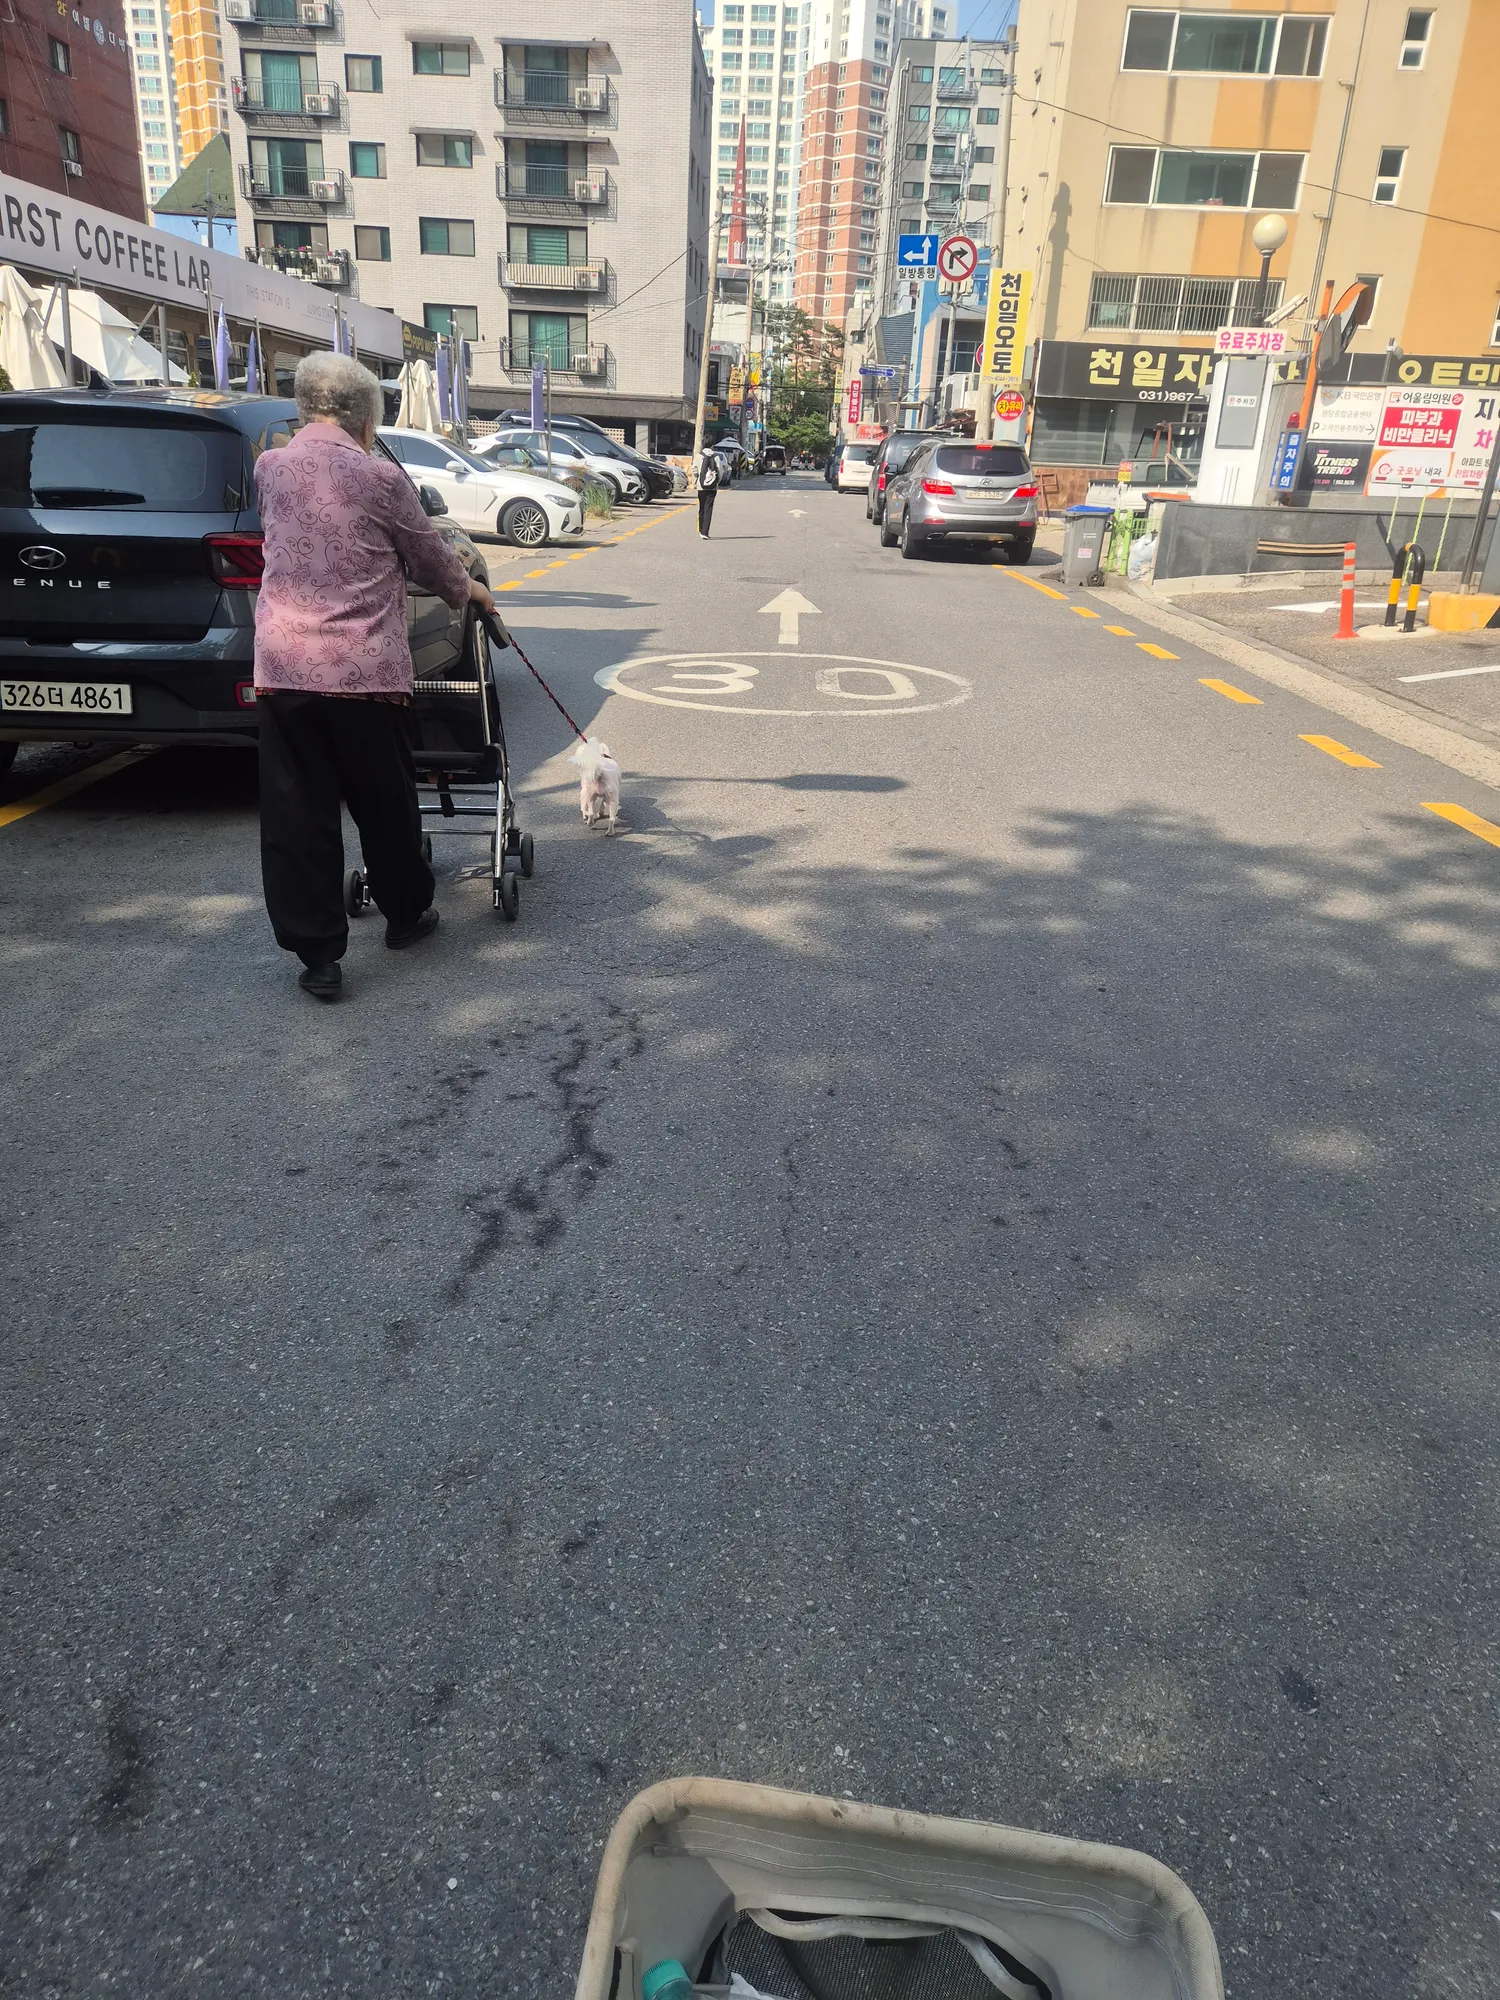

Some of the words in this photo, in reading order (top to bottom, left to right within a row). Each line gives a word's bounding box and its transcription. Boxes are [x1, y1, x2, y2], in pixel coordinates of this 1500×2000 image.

[56, 0, 68, 17] 2F
[75, 218, 168, 282] COFFEE
[898, 267, 936, 279] 일방통행
[245, 284, 259, 300] THIS
[260, 290, 284, 308] STATION
[991, 273, 1022, 374] 천일오토
[1218, 330, 1284, 351] 유료주차장
[1353, 392, 1382, 401] 국민은행
[1403, 392, 1452, 405] 어울림의원
[1474, 398, 1500, 420] 지
[1400, 410, 1443, 427] 피부과
[1382, 427, 1453, 445] 비만클리닉
[1316, 466, 1353, 475] TREND
[1461, 457, 1483, 467] 아파트
[1396, 466, 1422, 475] 굿모닝
[1424, 466, 1442, 476] 내과
[1455, 469, 1484, 479] 진입차량
[652, 660, 922, 701] 30
[3, 684, 64, 707] 326더
[70, 686, 123, 710] 4861
